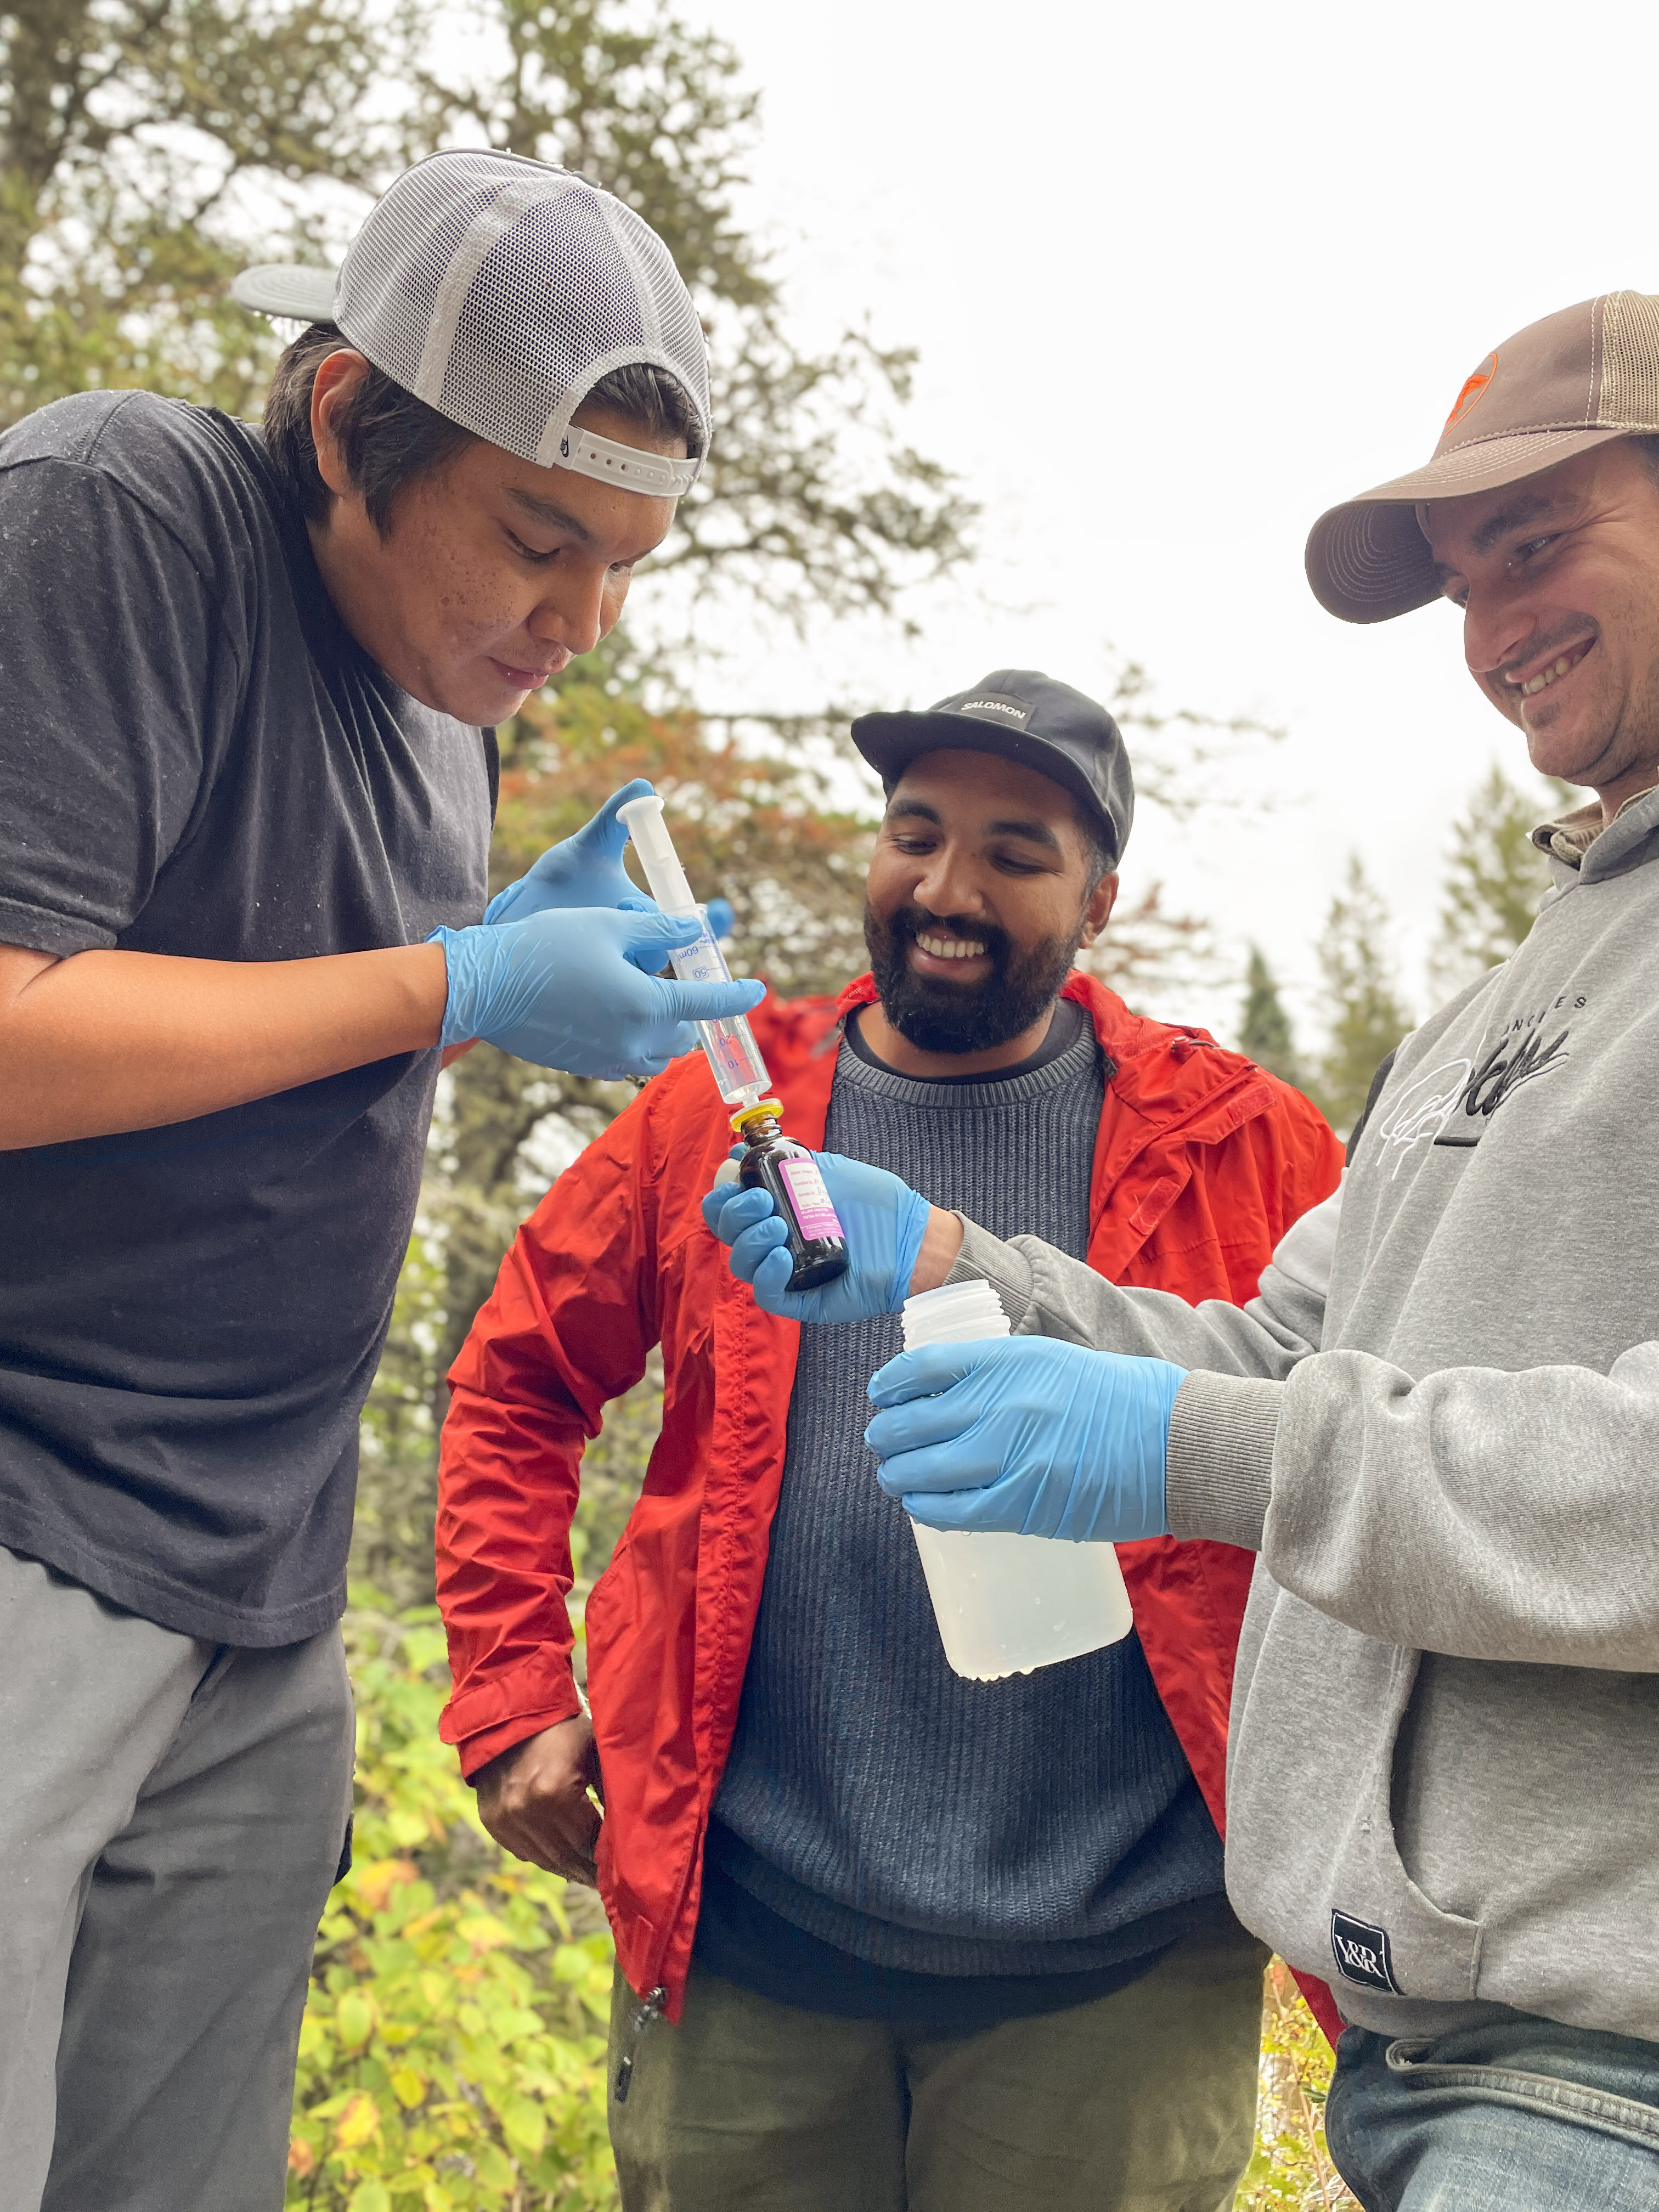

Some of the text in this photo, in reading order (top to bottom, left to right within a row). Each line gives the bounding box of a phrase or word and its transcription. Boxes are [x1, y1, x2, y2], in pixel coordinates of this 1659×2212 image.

[962, 701, 1026, 719] SALOMON
[695, 968, 707, 979] 50
[719, 1035, 733, 1047] 20
[728, 1059, 739, 1069] 10
[1335, 1934, 1386, 1979] V&R
